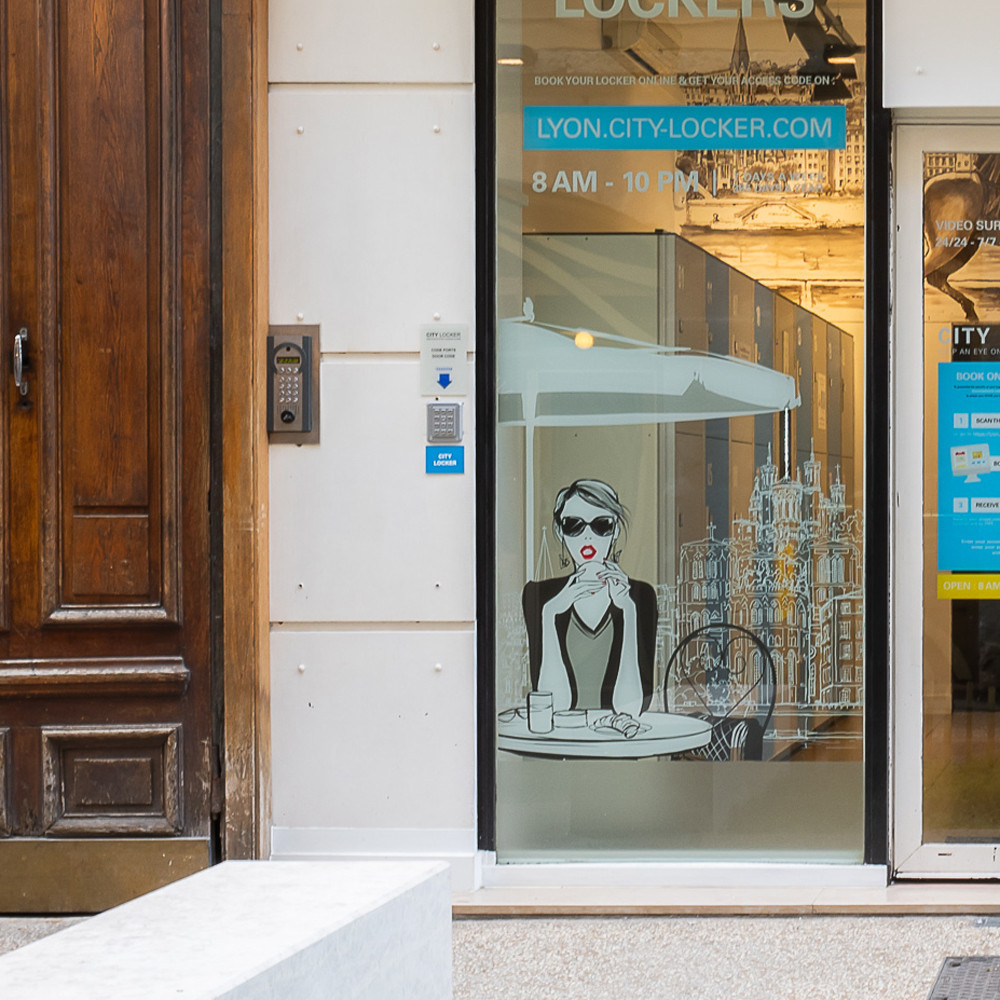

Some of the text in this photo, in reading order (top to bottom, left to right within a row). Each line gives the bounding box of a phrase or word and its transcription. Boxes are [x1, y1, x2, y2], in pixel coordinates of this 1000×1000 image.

[534, 75, 564, 87] BOOK
[565, 75, 594, 87] YOUR
[595, 75, 636, 87] LOCKER
[638, 75, 676, 87] ONLINE
[678, 75, 687, 87] &
[688, 75, 708, 87] GET
[710, 75, 739, 87] YOUR
[741, 75, 781, 87] ACCESS
[783, 75, 813, 87] CODE
[814, 75, 830, 87] ON
[537, 117, 832, 139] LYON.CITY-LOCKER.COM
[532, 171, 547, 193] 8
[552, 171, 597, 193] AM
[623, 171, 650, 193] 10
[658, 171, 699, 193] PM
[743, 172, 774, 182] DAYS
[779, 172, 787, 182] A
[935, 220, 973, 231] VIDEO
[935, 237, 968, 248] 24/24
[977, 237, 997, 248] 7/7
[938, 327, 991, 345] CITY
[959, 348, 971, 356] AN
[973, 348, 988, 356] EYE
[956, 372, 984, 381] BOOK
[943, 581, 971, 590] OPEN
[977, 581, 984, 590] 8
